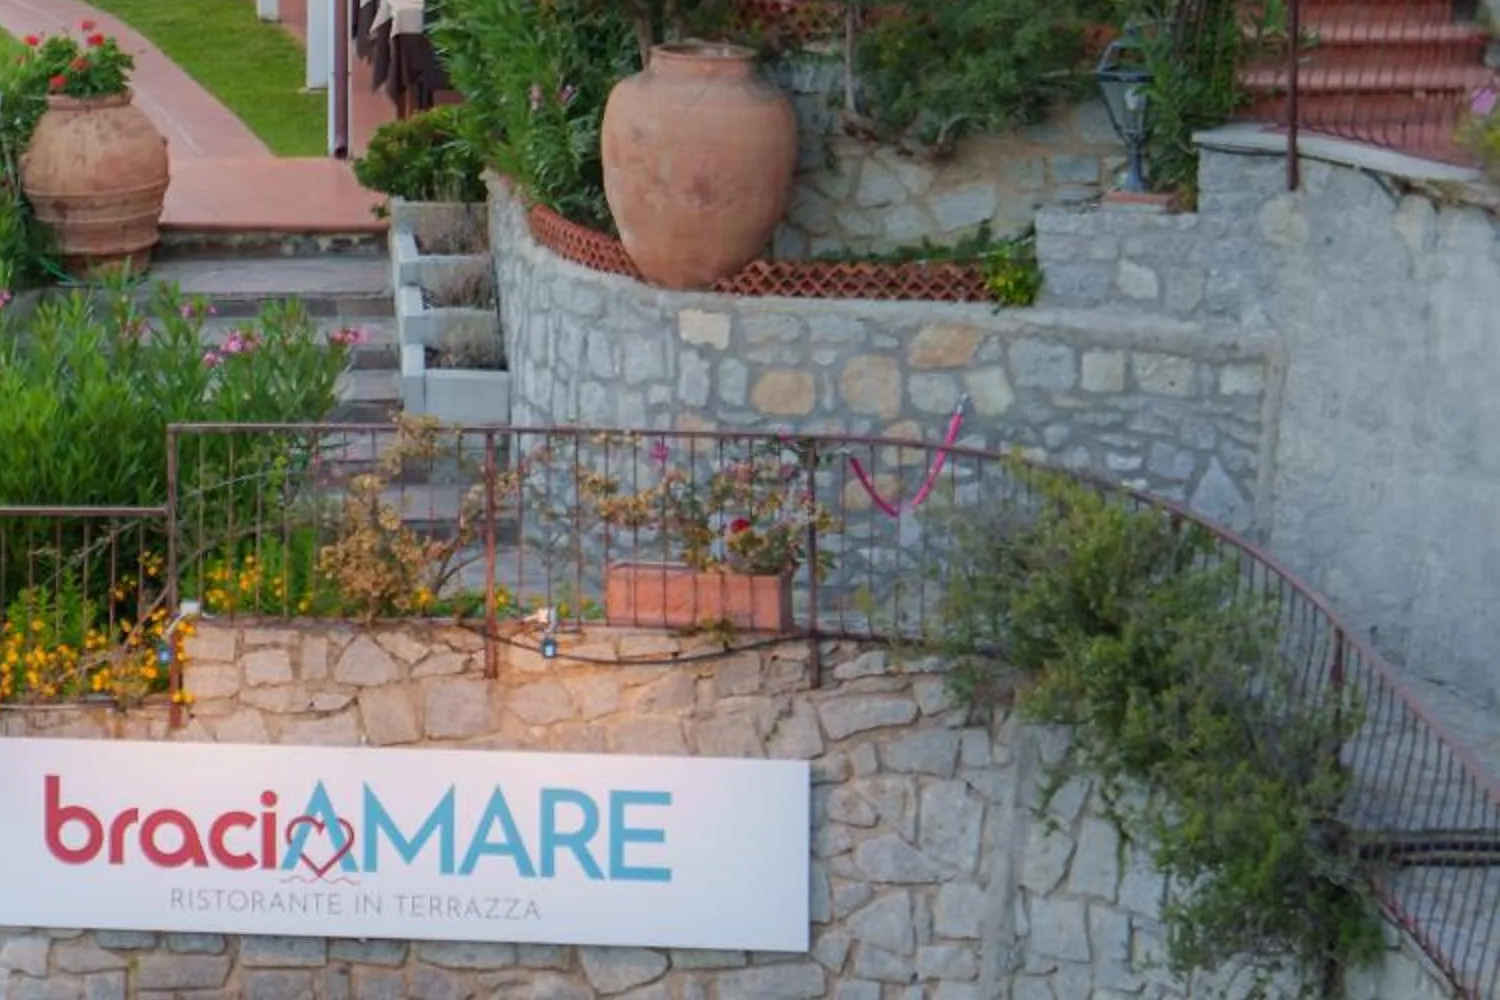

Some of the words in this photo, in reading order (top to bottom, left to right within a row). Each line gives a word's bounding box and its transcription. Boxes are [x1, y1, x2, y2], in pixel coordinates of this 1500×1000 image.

[44, 774, 673, 882] braciAMARE
[171, 886, 342, 916] RISTORANTE
[354, 893, 382, 916] IN
[395, 894, 543, 921] TERRAZZA
